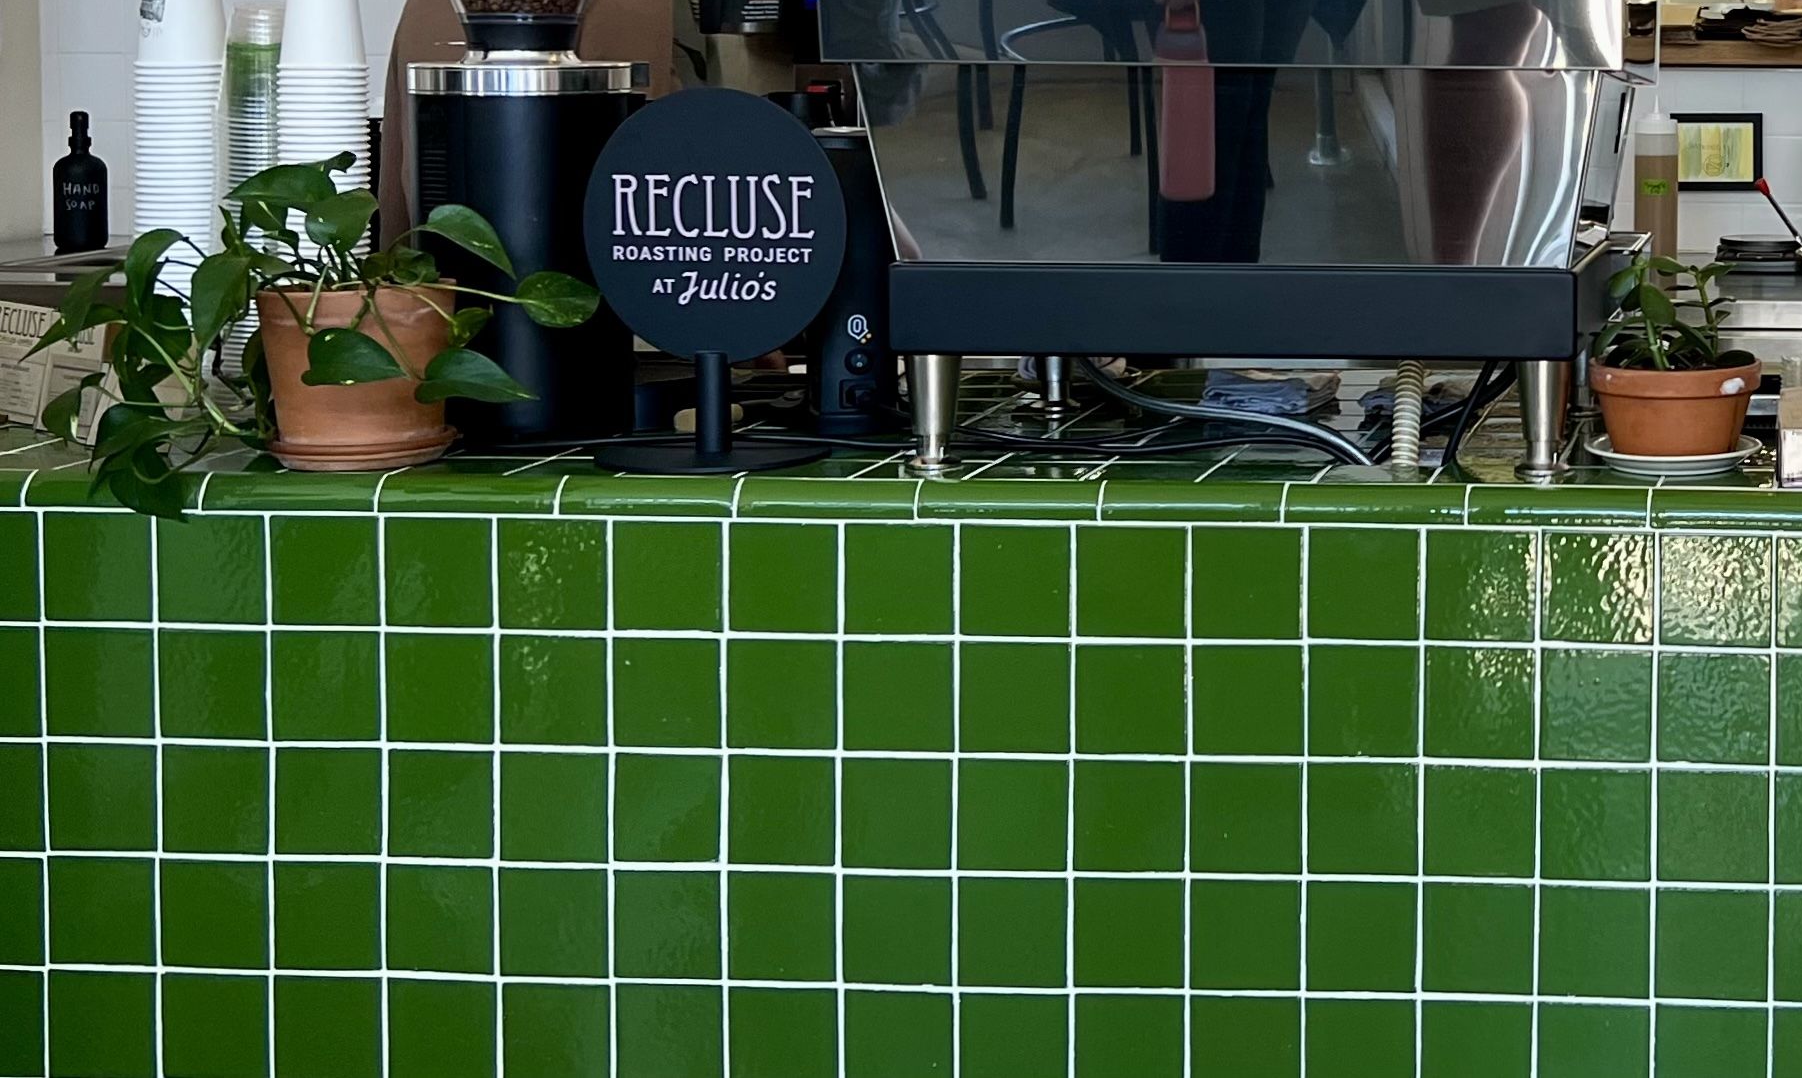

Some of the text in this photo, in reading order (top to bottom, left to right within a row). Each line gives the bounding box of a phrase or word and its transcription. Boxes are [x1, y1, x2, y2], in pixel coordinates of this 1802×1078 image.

[62, 182, 100, 195] HAND
[65, 199, 96, 211] SOAP
[611, 173, 815, 240] RECLUSE
[612, 245, 813, 263] ROASTING PROJECT
[651, 271, 777, 306] AT Julio's
[0, 306, 47, 339] ECLUSE
